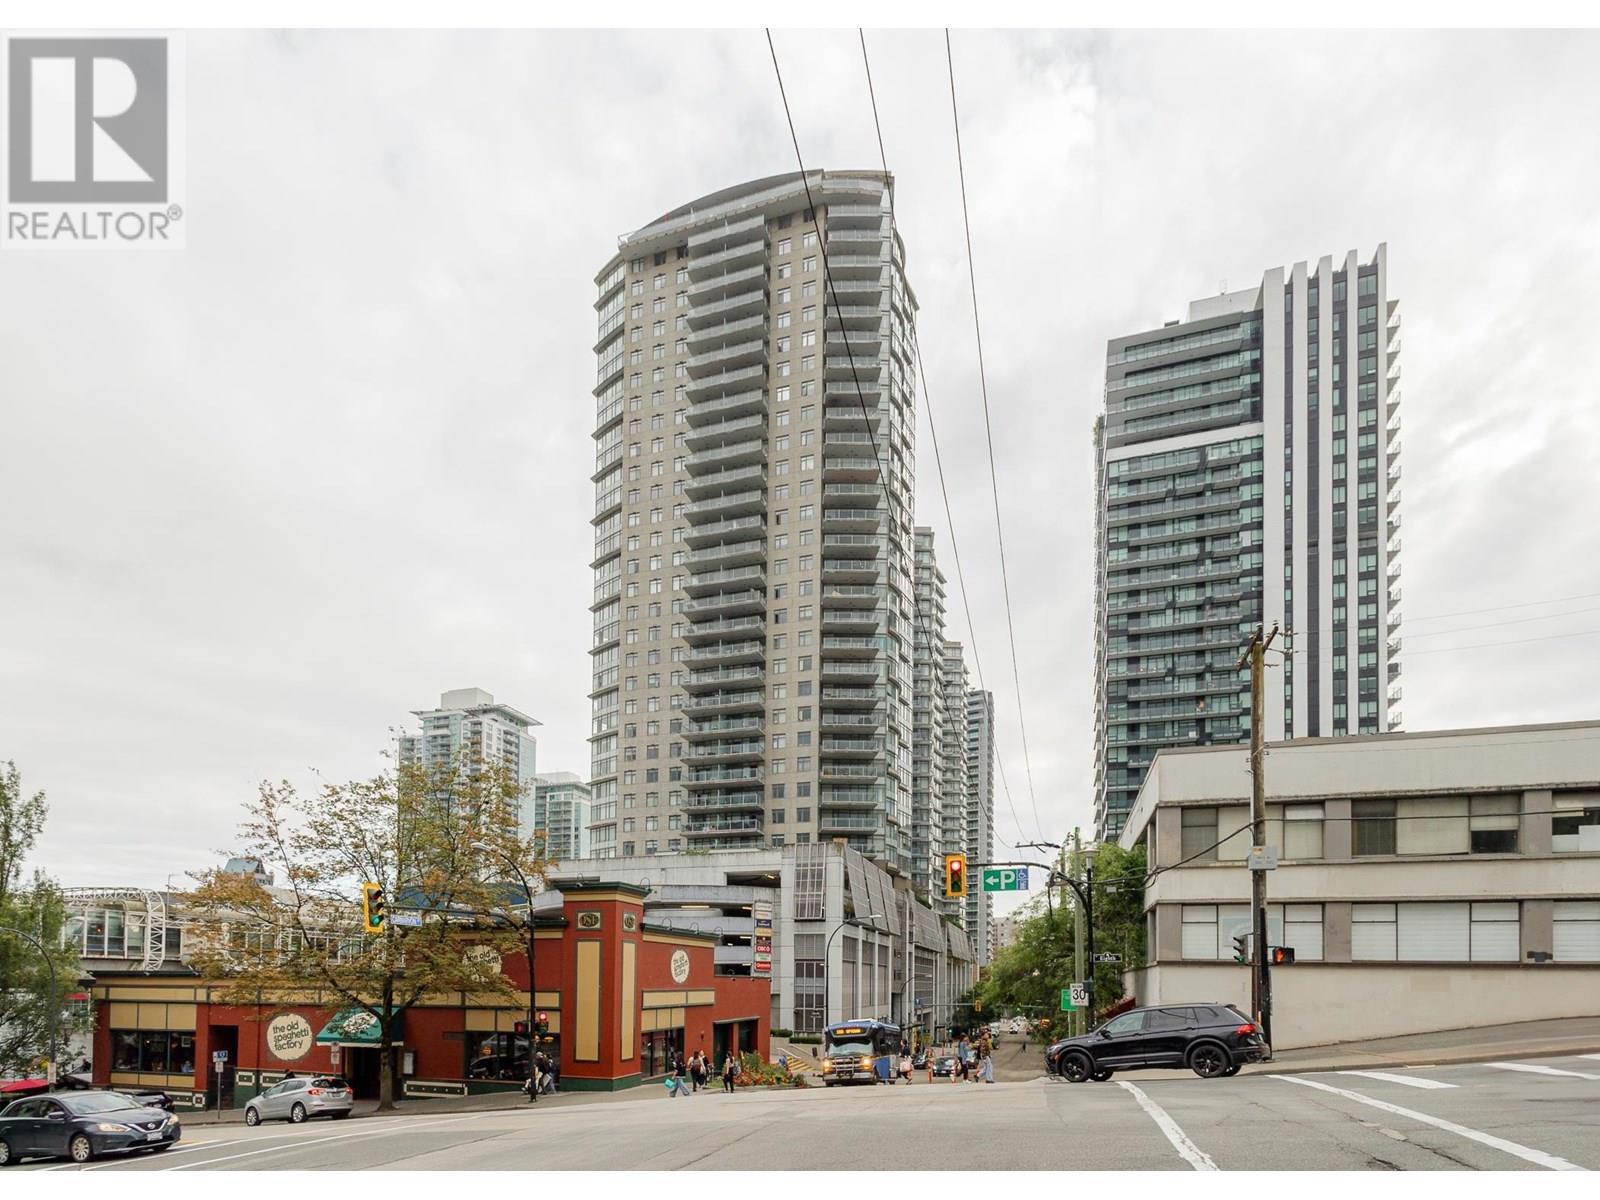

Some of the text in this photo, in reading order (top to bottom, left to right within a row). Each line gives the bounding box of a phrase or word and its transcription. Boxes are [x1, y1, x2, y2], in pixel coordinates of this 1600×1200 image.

[1000, 870, 1016, 890] P
[1072, 989, 1086, 1001] 30
[273, 1020, 299, 1035] the old
[273, 1026, 310, 1042] spaghetti
[273, 1039, 304, 1051] factory
